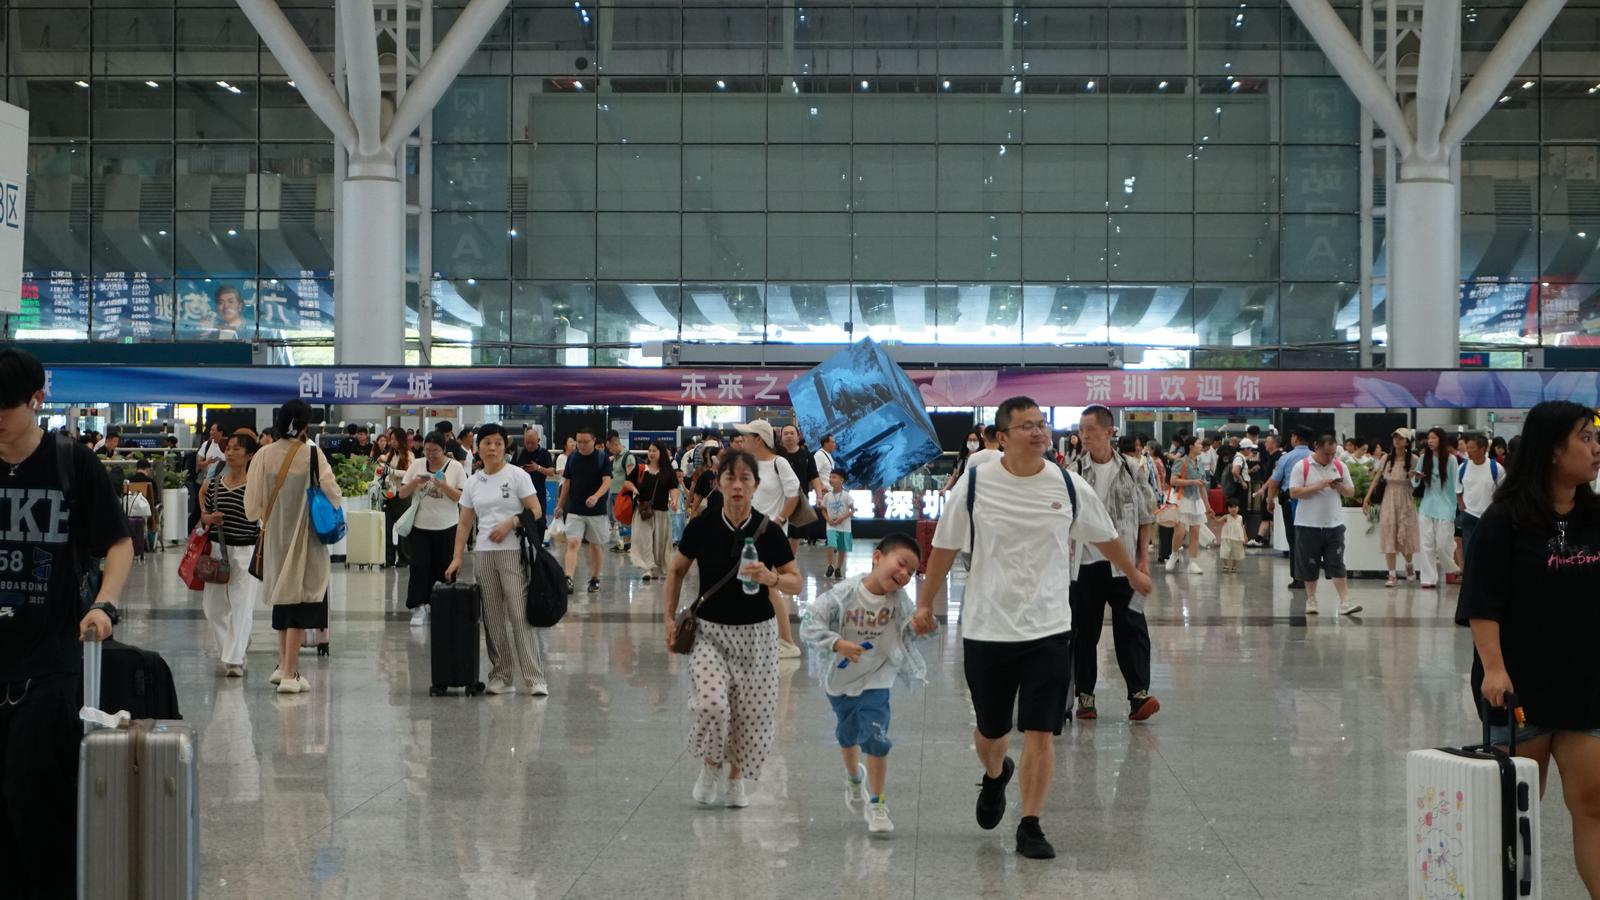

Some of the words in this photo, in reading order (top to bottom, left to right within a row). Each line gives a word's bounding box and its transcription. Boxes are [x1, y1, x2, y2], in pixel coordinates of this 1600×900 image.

[298, 372, 432, 398] 创新之城
[681, 373, 798, 400] 未来之
[1086, 375, 1260, 401] 深圳欢迎你
[0, 488, 70, 543] KE
[808, 489, 950, 519] 是深圳
